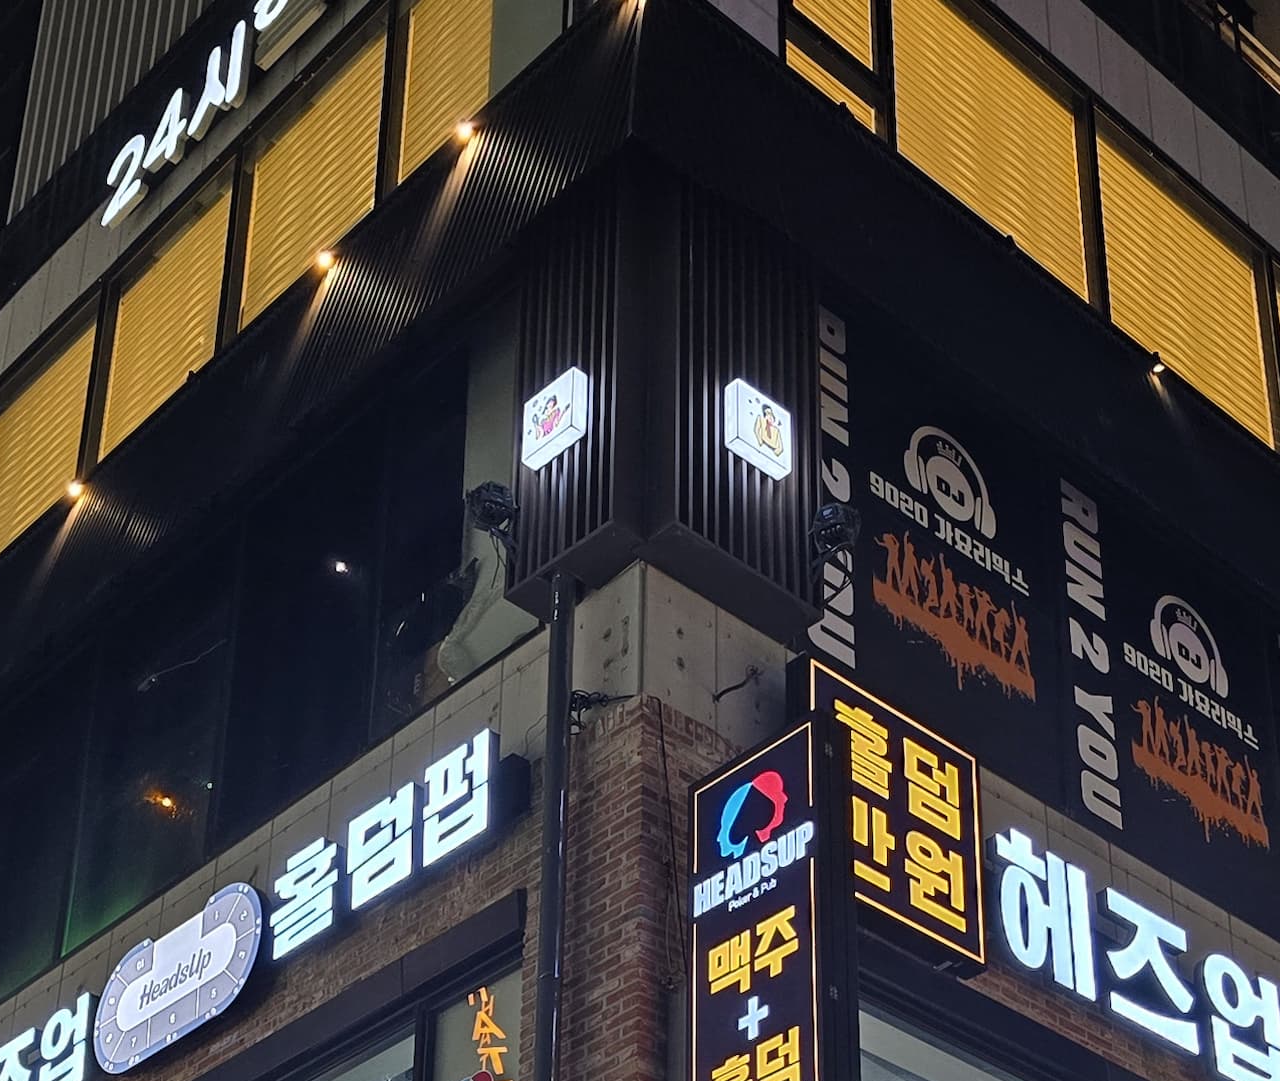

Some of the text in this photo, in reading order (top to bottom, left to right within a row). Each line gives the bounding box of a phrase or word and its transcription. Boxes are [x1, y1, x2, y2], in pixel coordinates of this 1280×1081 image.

[101, 0, 288, 227] 24시
[870, 470, 929, 529] 9020
[807, 515, 857, 671] OU
[1060, 477, 1123, 831] RUN 2 YOU
[1123, 642, 1175, 693] 9020
[833, 697, 963, 842] 홀덤
[270, 727, 492, 962] 홀덤펍
[693, 820, 815, 919] HEADSUP
[728, 878, 777, 912] Poker Pub
[138, 947, 213, 1011] HeadsUp
[706, 904, 801, 997] 맥주
